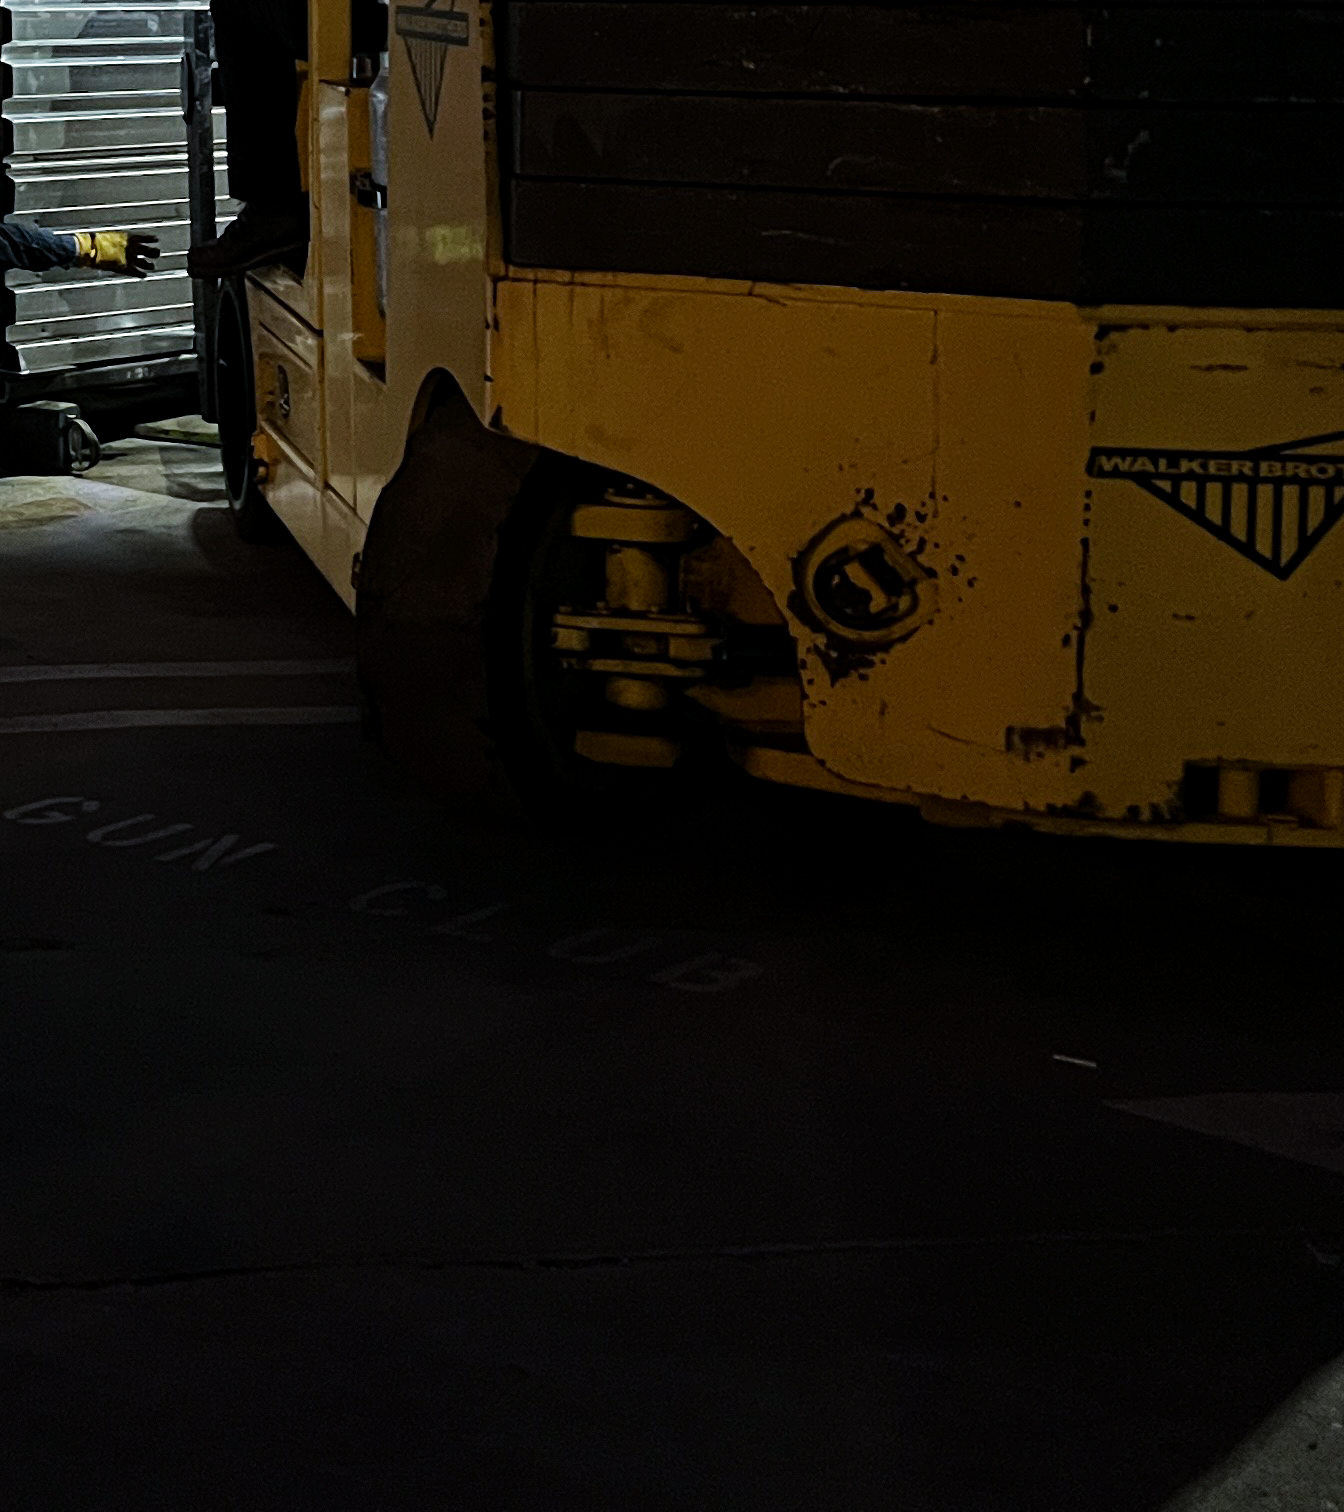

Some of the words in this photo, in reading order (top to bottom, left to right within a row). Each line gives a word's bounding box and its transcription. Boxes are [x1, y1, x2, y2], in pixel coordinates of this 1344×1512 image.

[1093, 454, 1256, 478] WALKER
[3, 795, 281, 872] GUN
[348, 881, 765, 992] CLUB
